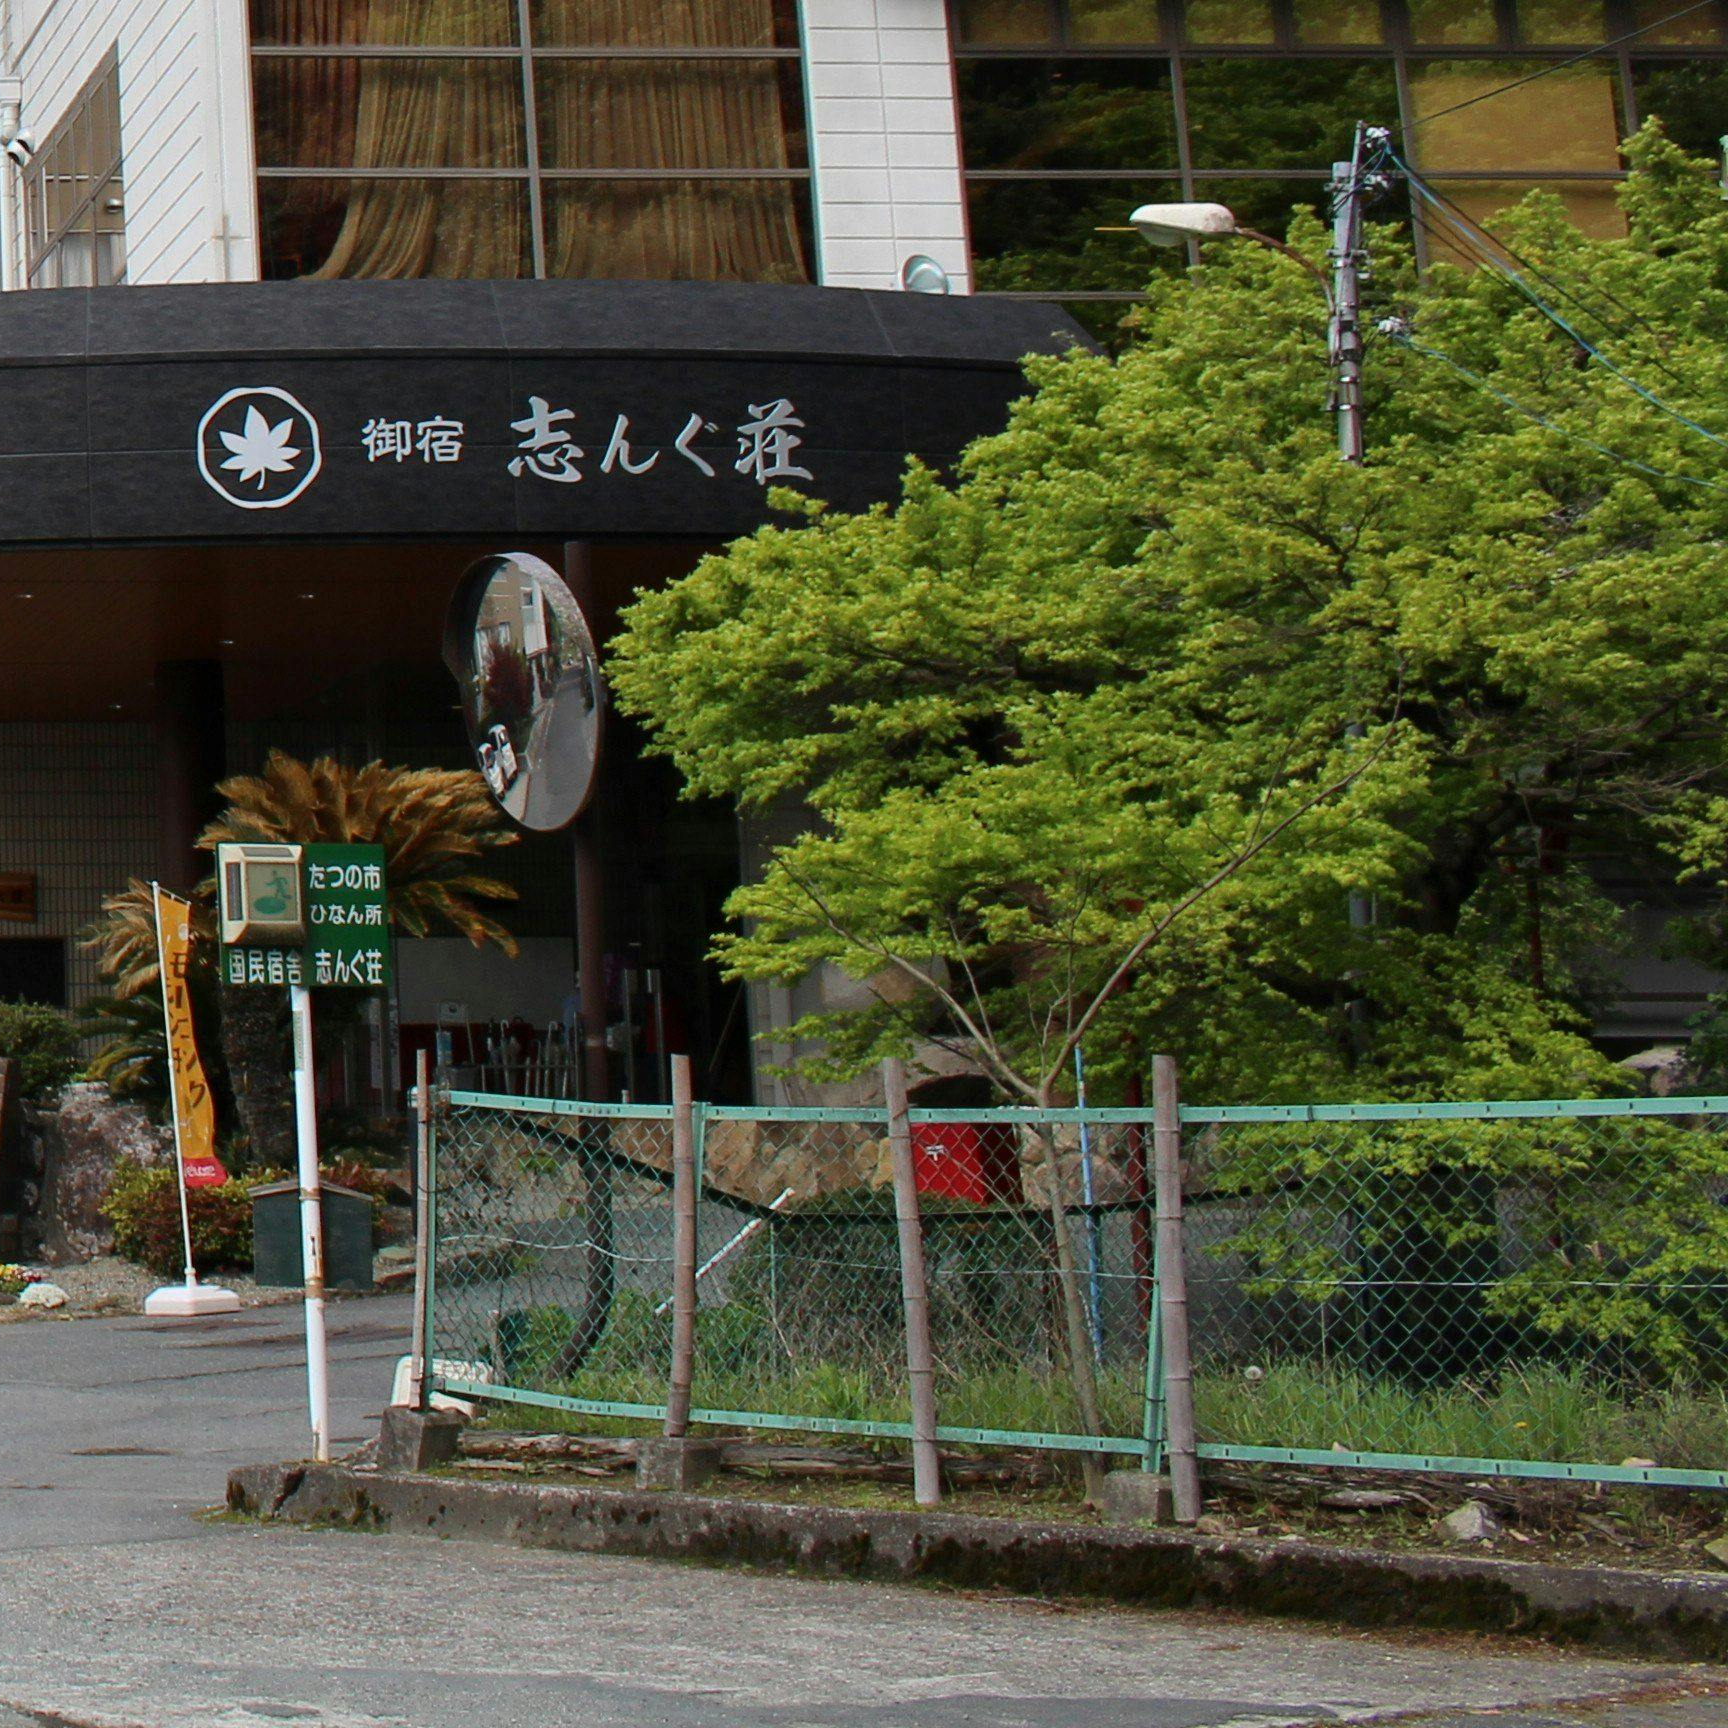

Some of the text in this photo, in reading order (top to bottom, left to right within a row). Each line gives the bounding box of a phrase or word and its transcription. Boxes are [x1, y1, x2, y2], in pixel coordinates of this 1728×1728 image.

[361, 396, 815, 486] 御宿 志んぐ荘
[308, 863, 382, 891] たつの市
[310, 904, 383, 926] ひなん所
[229, 948, 384, 985] 国民宿舎 志んぐ荘
